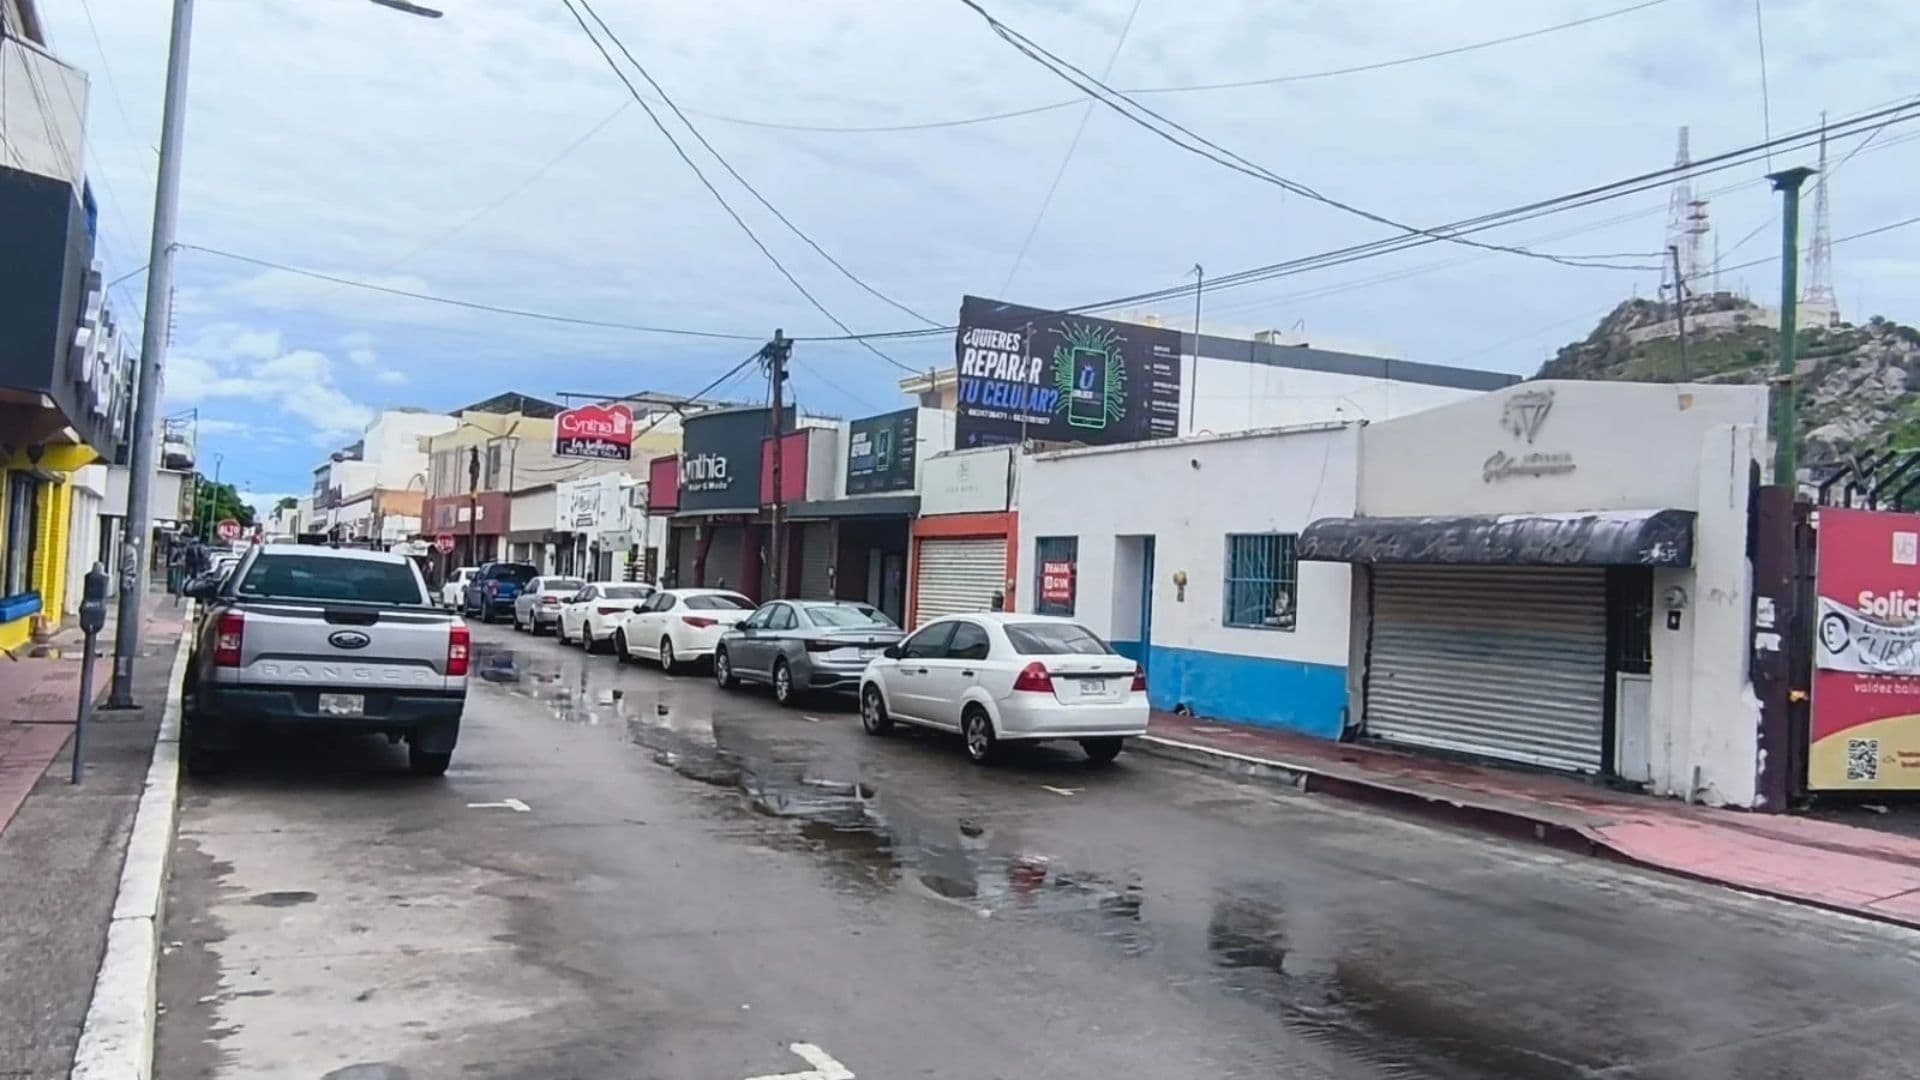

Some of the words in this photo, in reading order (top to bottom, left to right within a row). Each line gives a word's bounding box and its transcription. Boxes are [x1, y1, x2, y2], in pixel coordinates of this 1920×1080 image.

[962, 326, 1021, 351] ¿QUIERES
[961, 347, 1043, 385] REPARAR
[960, 377, 980, 404] TU
[982, 380, 1059, 413] CELULAR?
[562, 414, 613, 434] Cynthia
[261, 662, 431, 682] RANGER
